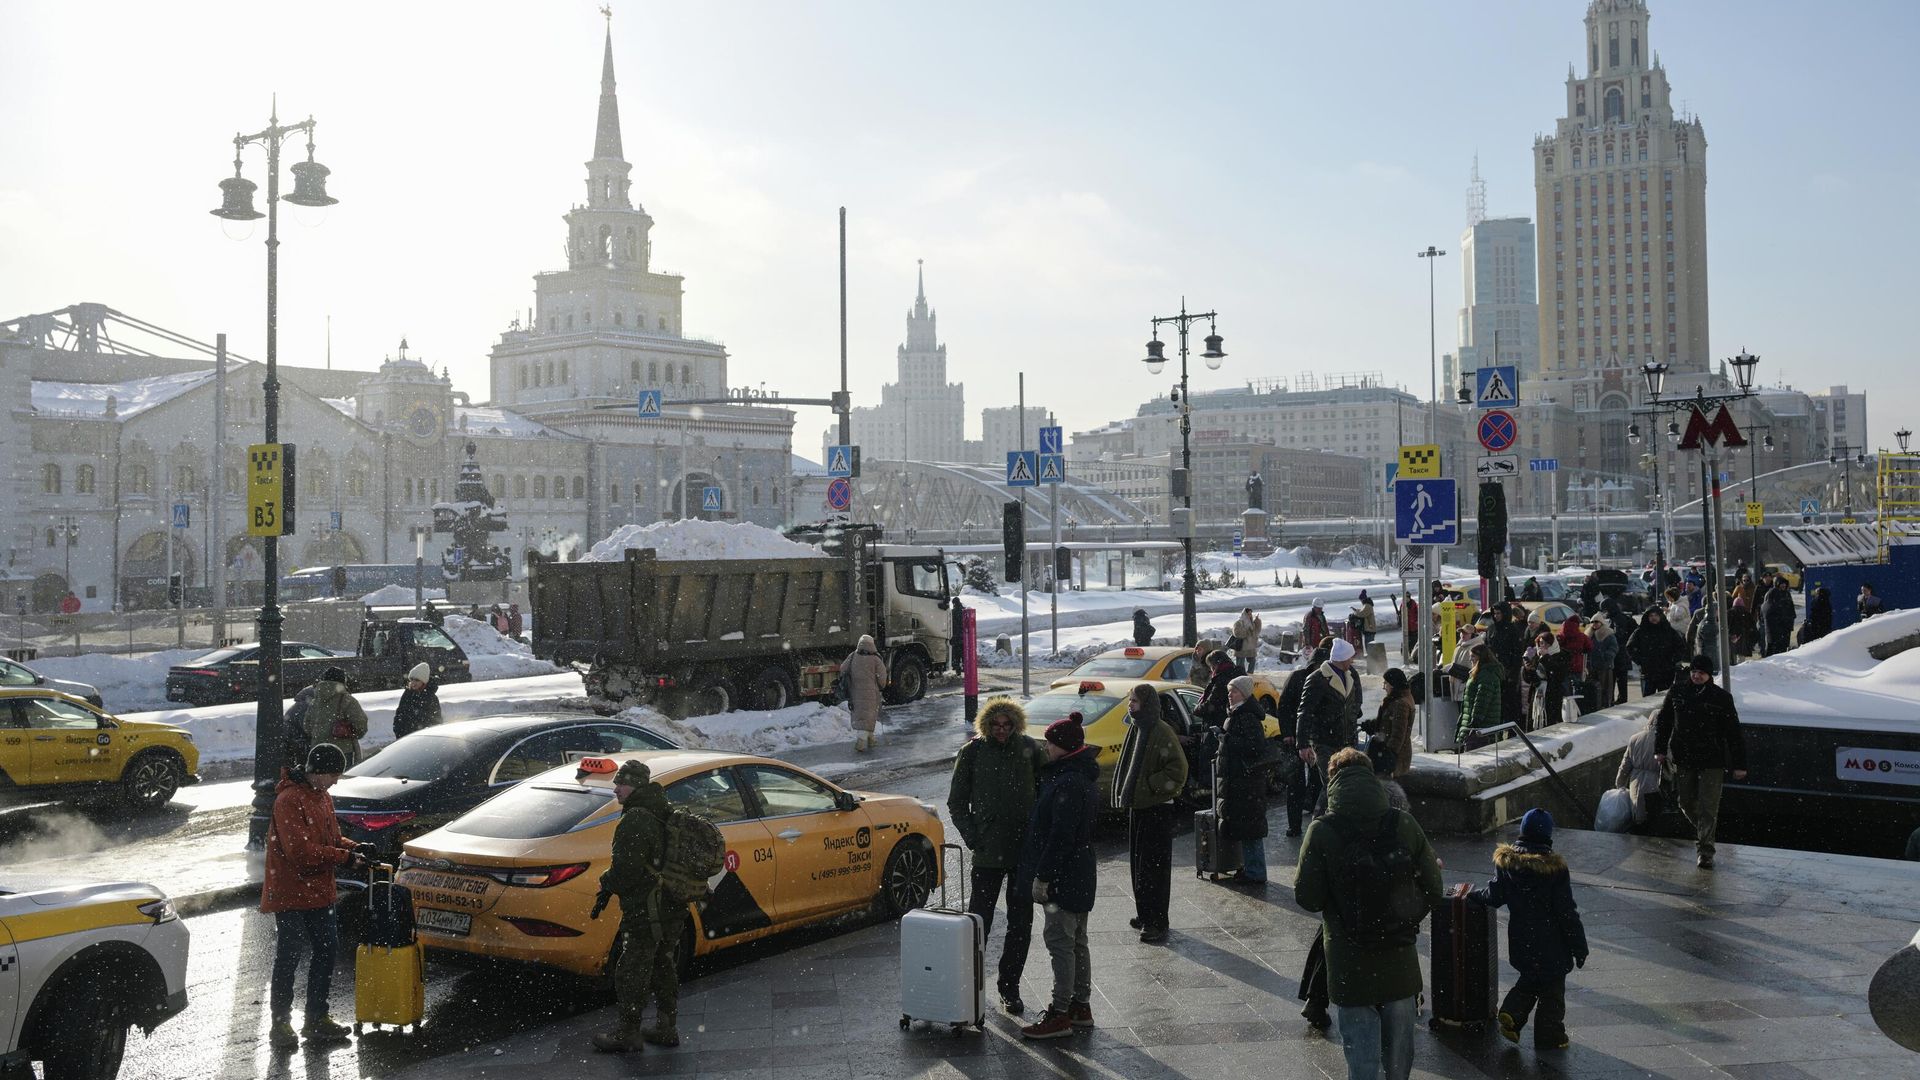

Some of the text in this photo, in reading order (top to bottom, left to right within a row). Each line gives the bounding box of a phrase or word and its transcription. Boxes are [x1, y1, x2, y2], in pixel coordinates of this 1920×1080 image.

[1678, 401, 1748, 450] М
[97, 735, 110, 744] Go
[86, 746, 110, 756] Тси
[1894, 761, 1920, 770] Комсо
[823, 831, 870, 851] Яндекс Go
[754, 847, 773, 863] 034
[847, 850, 872, 865] Такси
[818, 869, 837, 880] (495)
[442, 876, 490, 895] ВОДИТЕЛЕЙ
